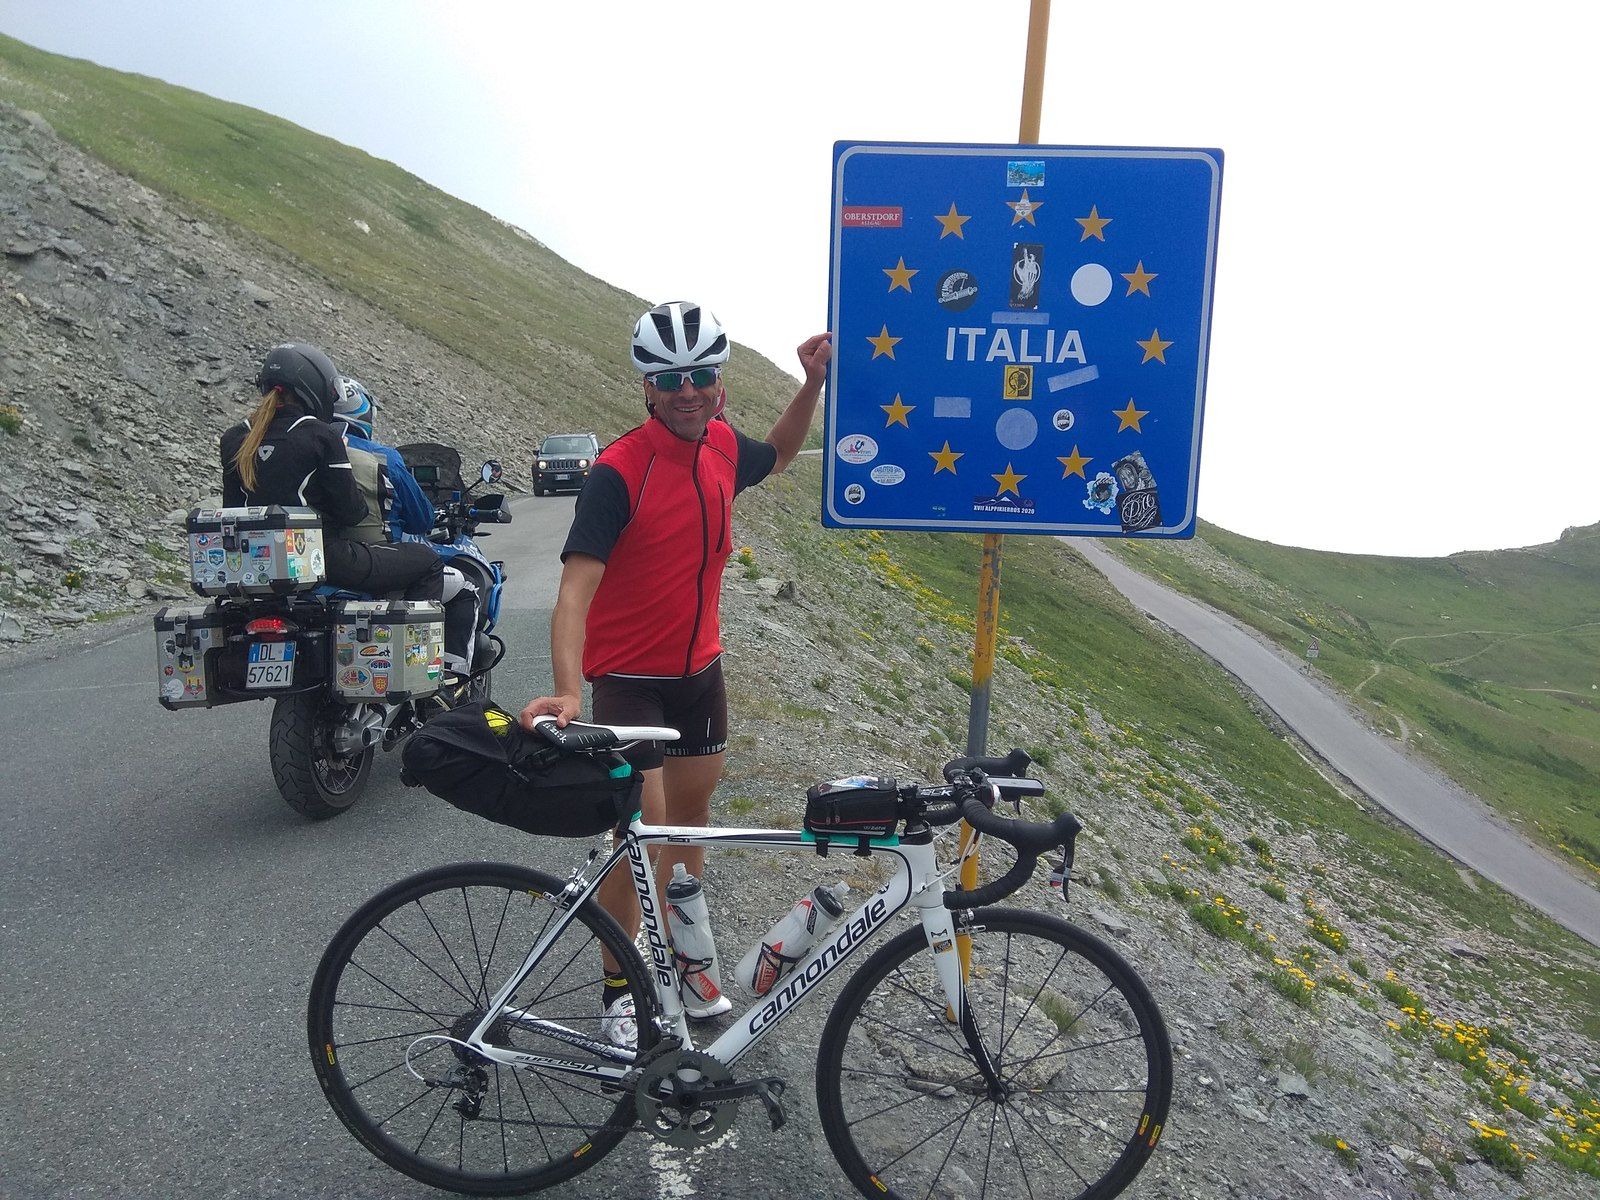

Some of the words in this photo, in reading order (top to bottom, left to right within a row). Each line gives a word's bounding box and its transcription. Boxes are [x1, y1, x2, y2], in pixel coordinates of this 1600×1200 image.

[844, 212, 900, 221] OBERSTDORF
[945, 326, 1087, 364] ITALIA
[1021, 507, 1036, 515] 2020
[260, 644, 276, 661] DL
[248, 664, 290, 684] 57621
[627, 829, 672, 987] cannondale
[748, 898, 888, 1036] cannondale
[513, 1054, 600, 1073] SUPERSIX
